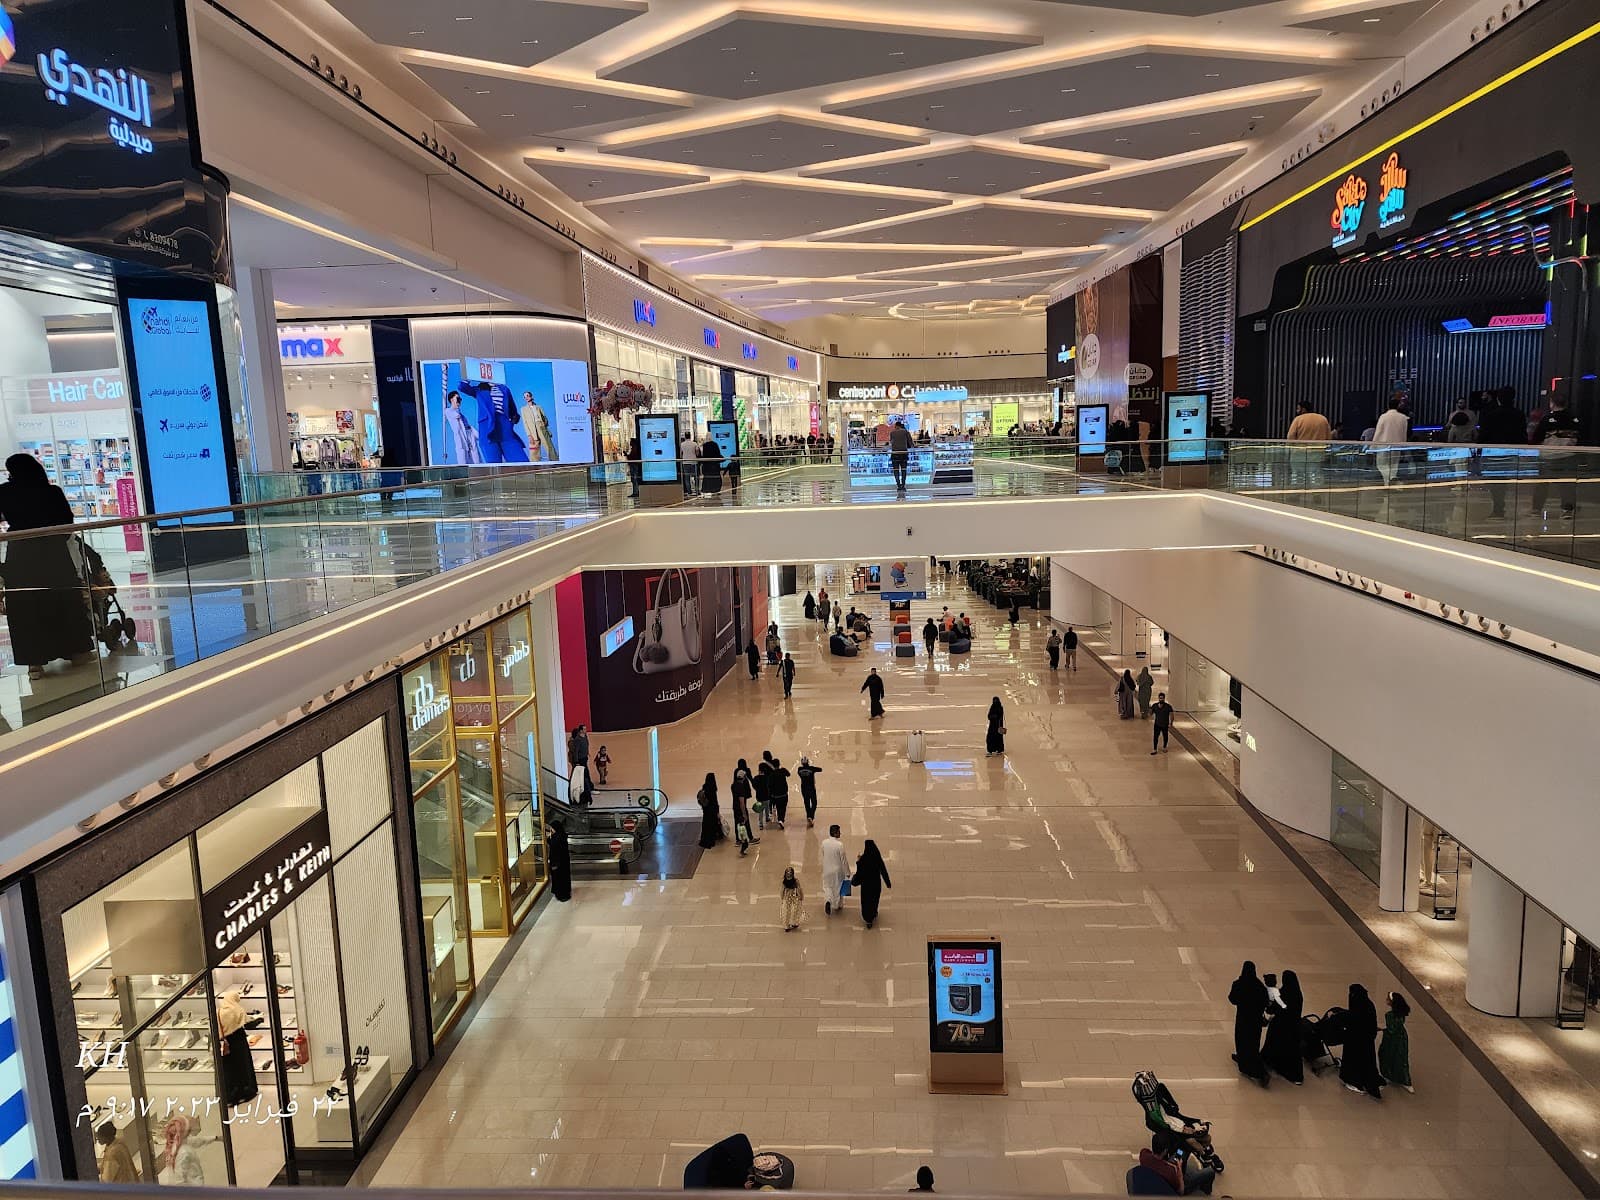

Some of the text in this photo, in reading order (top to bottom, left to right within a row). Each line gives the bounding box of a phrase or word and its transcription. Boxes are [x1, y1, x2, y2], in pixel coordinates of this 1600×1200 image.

[37, 48, 152, 127] النهدي
[109, 116, 153, 153] صيدلية
[281, 338, 344, 358] max
[47, 381, 88, 403] Hair
[838, 385, 887, 400] centrepoint
[655, 684, 687, 703] بطريقتك
[264, 872, 273, 886] &
[215, 845, 331, 949] CHARLES & KEITH
